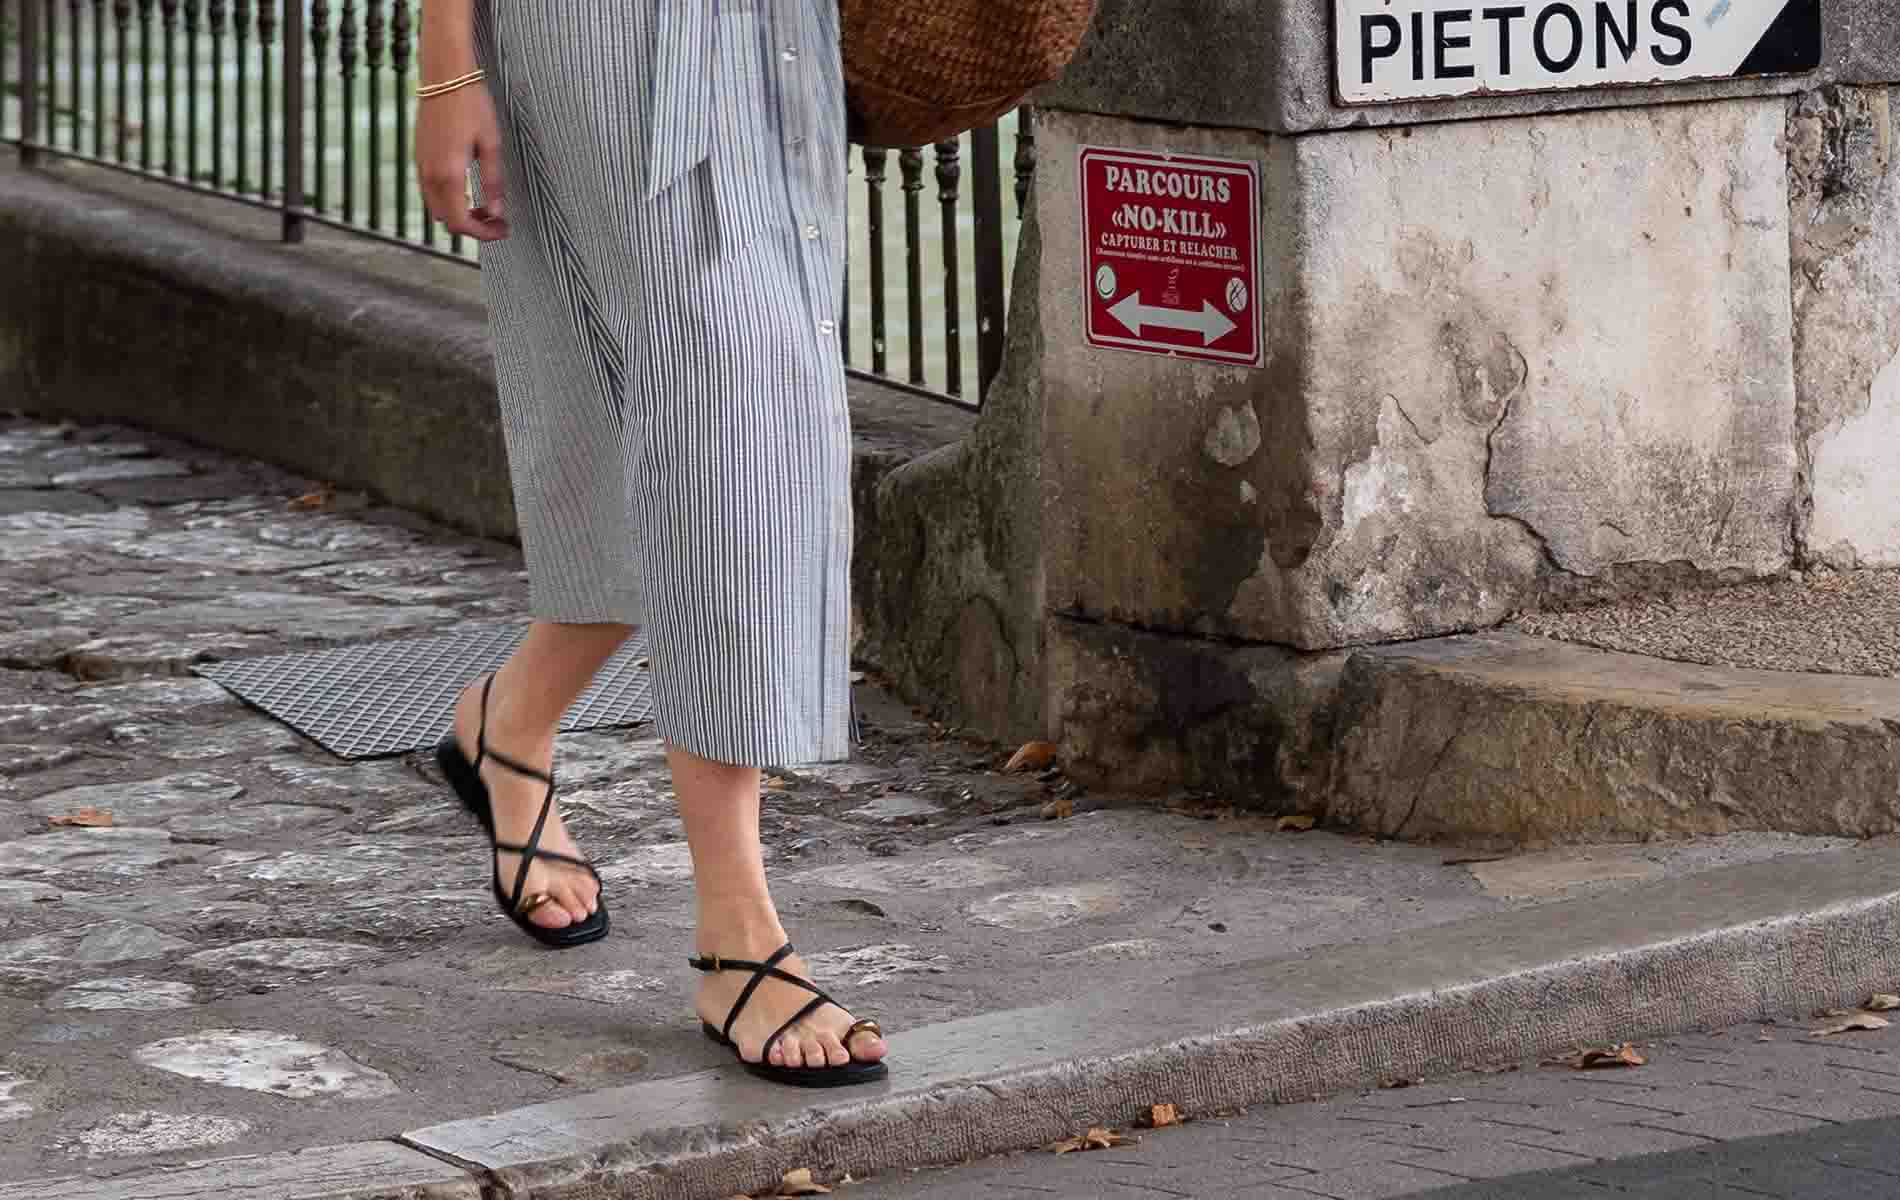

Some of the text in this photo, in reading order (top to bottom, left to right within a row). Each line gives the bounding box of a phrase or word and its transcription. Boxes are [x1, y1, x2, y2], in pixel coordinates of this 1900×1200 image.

[1104, 165, 1231, 203] PARCOURS
[1101, 232, 1161, 252] CAPTURER
[1163, 239, 1177, 253] ET
[1180, 242, 1238, 261] RELACHER
